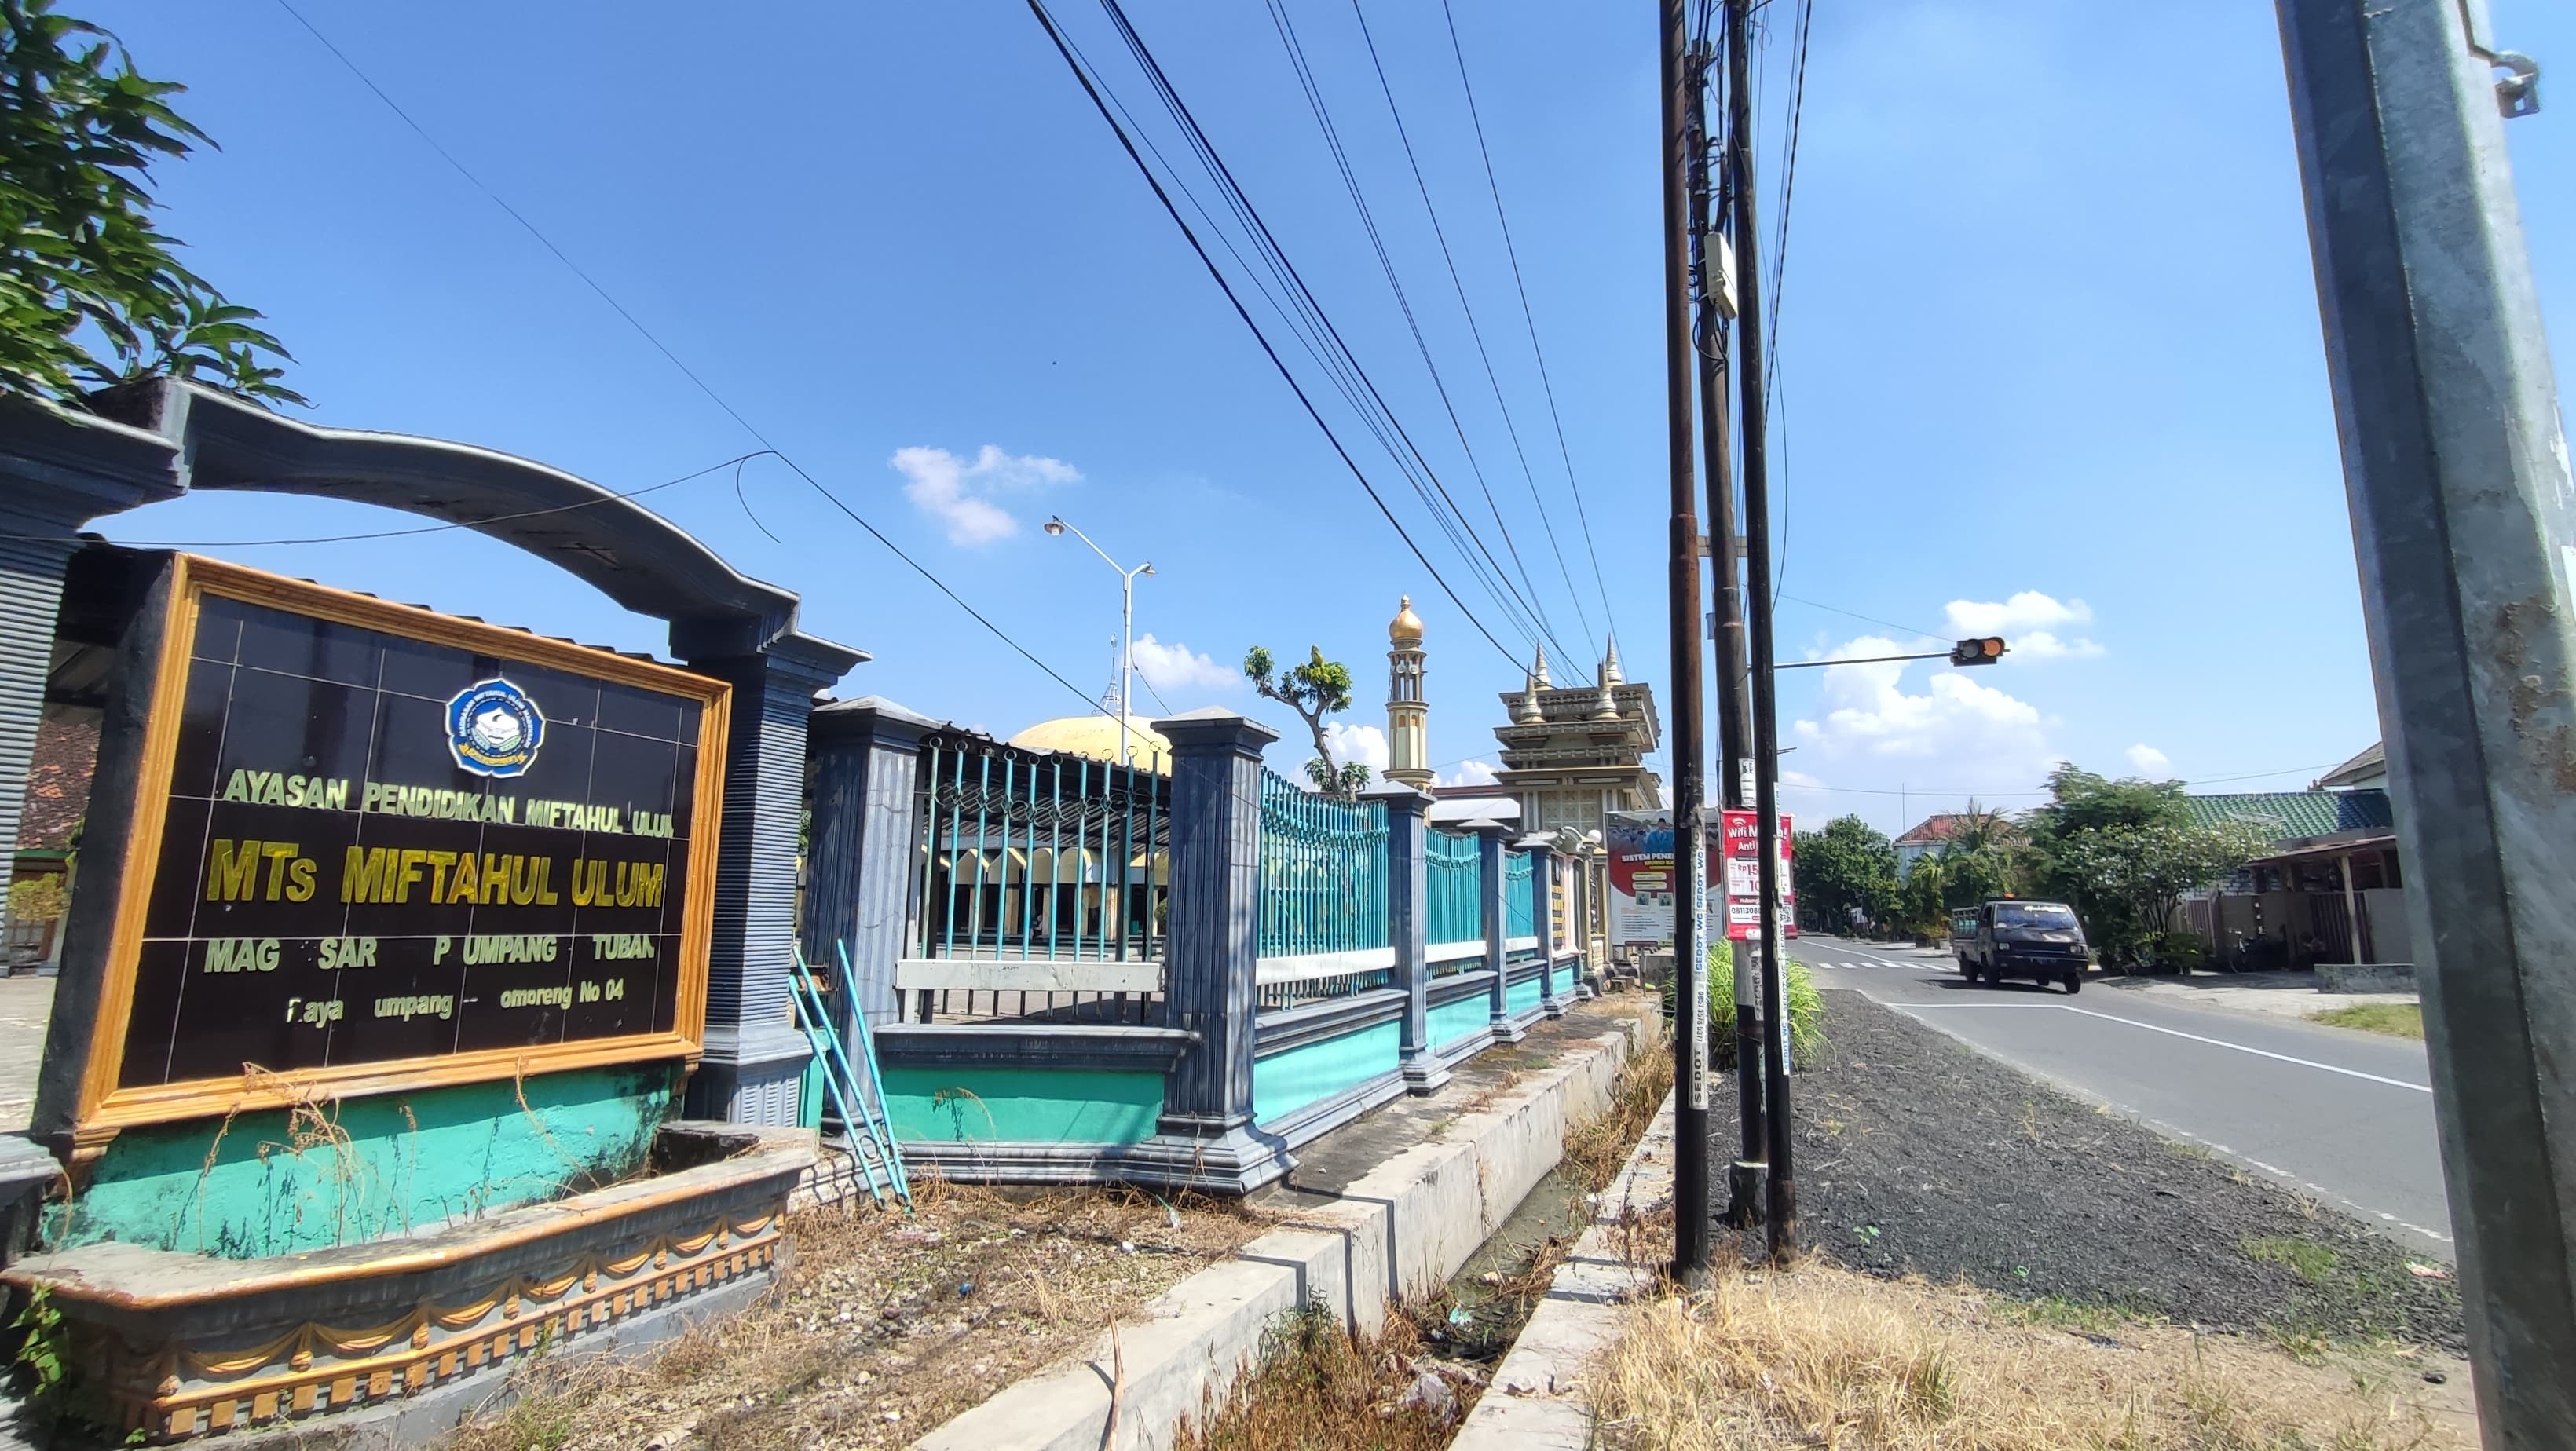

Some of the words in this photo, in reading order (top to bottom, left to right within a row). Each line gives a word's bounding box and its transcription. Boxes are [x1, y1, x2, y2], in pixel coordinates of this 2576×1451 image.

[222, 769, 349, 810] AYASAN
[364, 782, 515, 824] PENDIDIKAN
[526, 799, 624, 833] MIFTAHUL
[1728, 827, 1747, 839] Wifi
[1737, 841, 1755, 851] Anti
[1621, 853, 1651, 862] SISTEM
[1696, 851, 1703, 869] WC
[206, 838, 317, 902] MTs
[340, 846, 558, 905] MIFTAHUL
[571, 858, 664, 908] ULUM
[1696, 912, 1703, 930] WC
[374, 992, 454, 1021] umpang
[579, 980, 601, 1003] No
[605, 978, 624, 1001] 04
[1693, 1049, 1702, 1103] SEDOT
